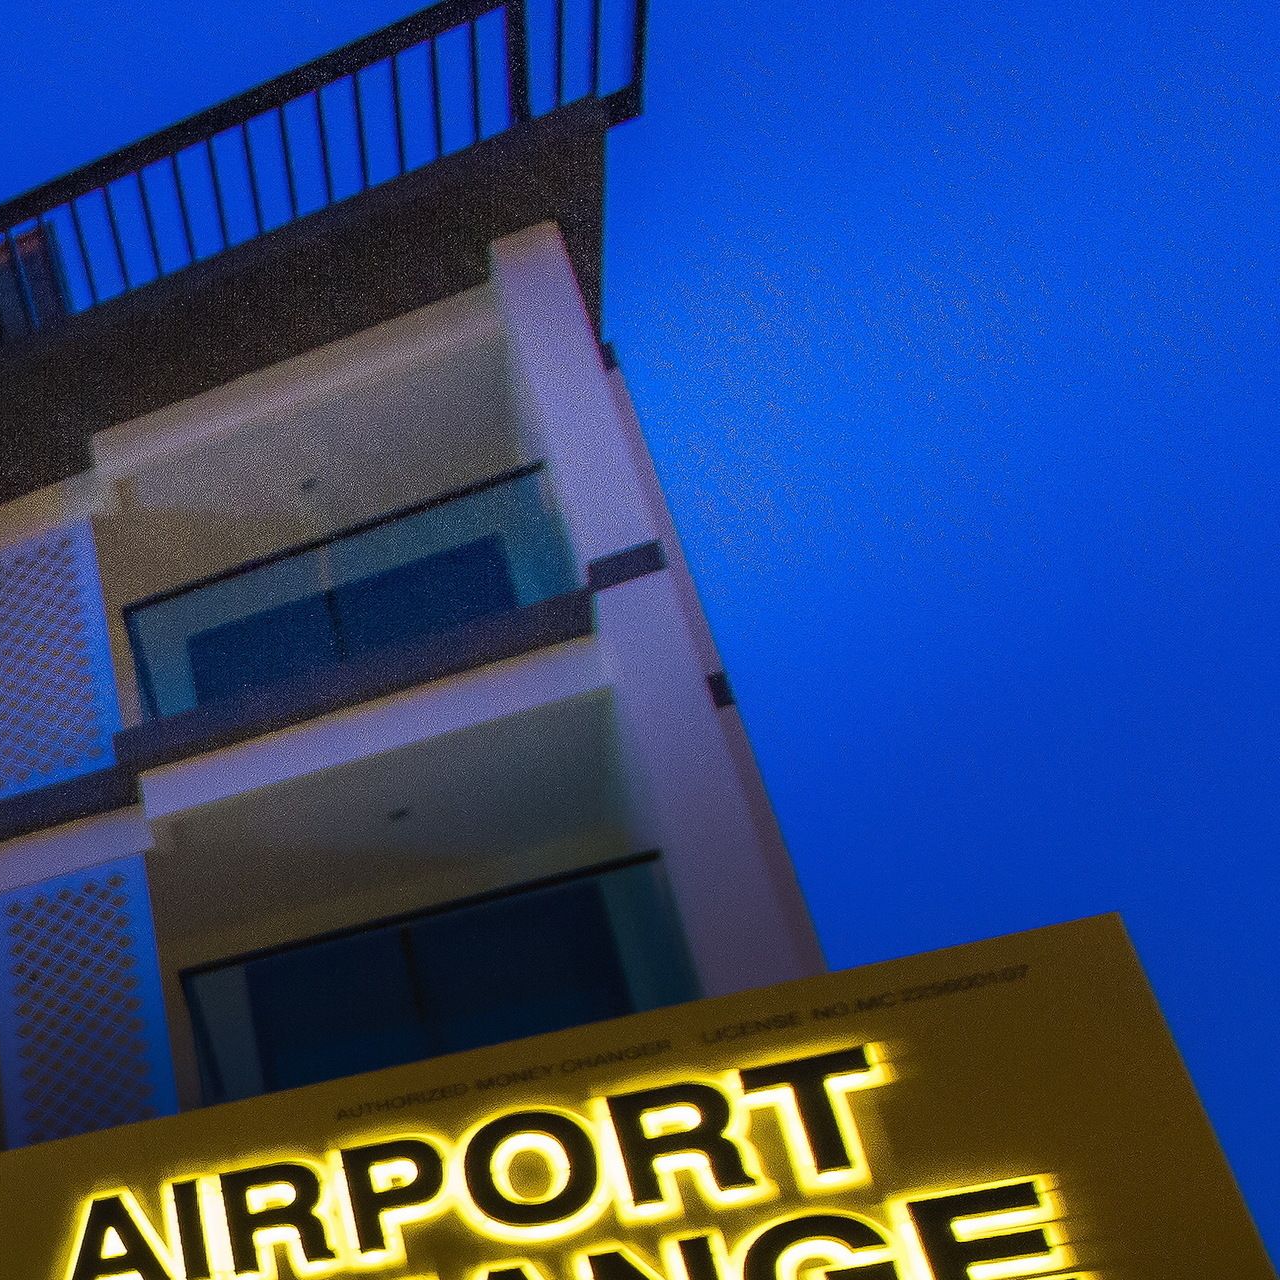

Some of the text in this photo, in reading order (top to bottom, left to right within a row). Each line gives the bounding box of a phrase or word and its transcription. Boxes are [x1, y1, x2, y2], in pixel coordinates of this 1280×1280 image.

[335, 1081, 470, 1121] AUTHORIZED
[475, 1062, 554, 1093] MONEY
[559, 1038, 674, 1074] CHANGER
[701, 1011, 799, 1045] LICENSE
